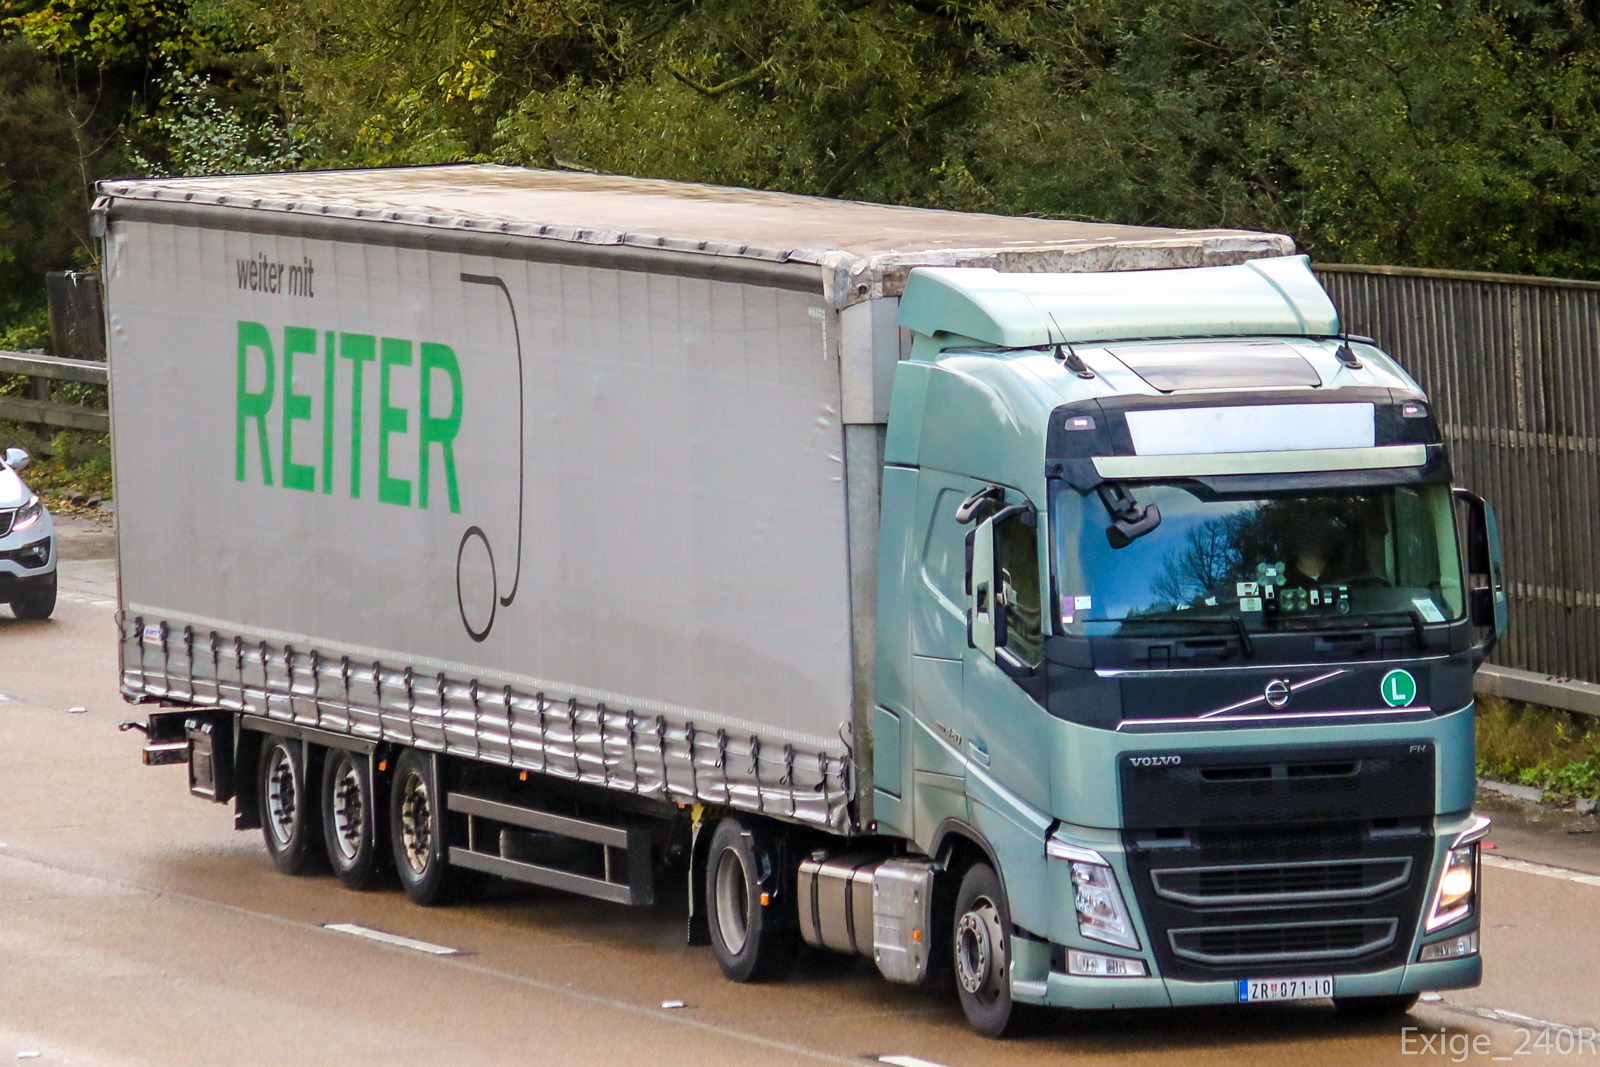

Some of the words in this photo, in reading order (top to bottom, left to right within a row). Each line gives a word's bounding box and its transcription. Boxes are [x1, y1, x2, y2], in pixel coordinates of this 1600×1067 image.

[236, 252, 284, 294] weiter
[288, 256, 314, 298] mit
[235, 320, 463, 514] REITER
[1391, 678, 1406, 701] L
[1409, 745, 1427, 754] FH
[1129, 756, 1181, 767] VOLVO
